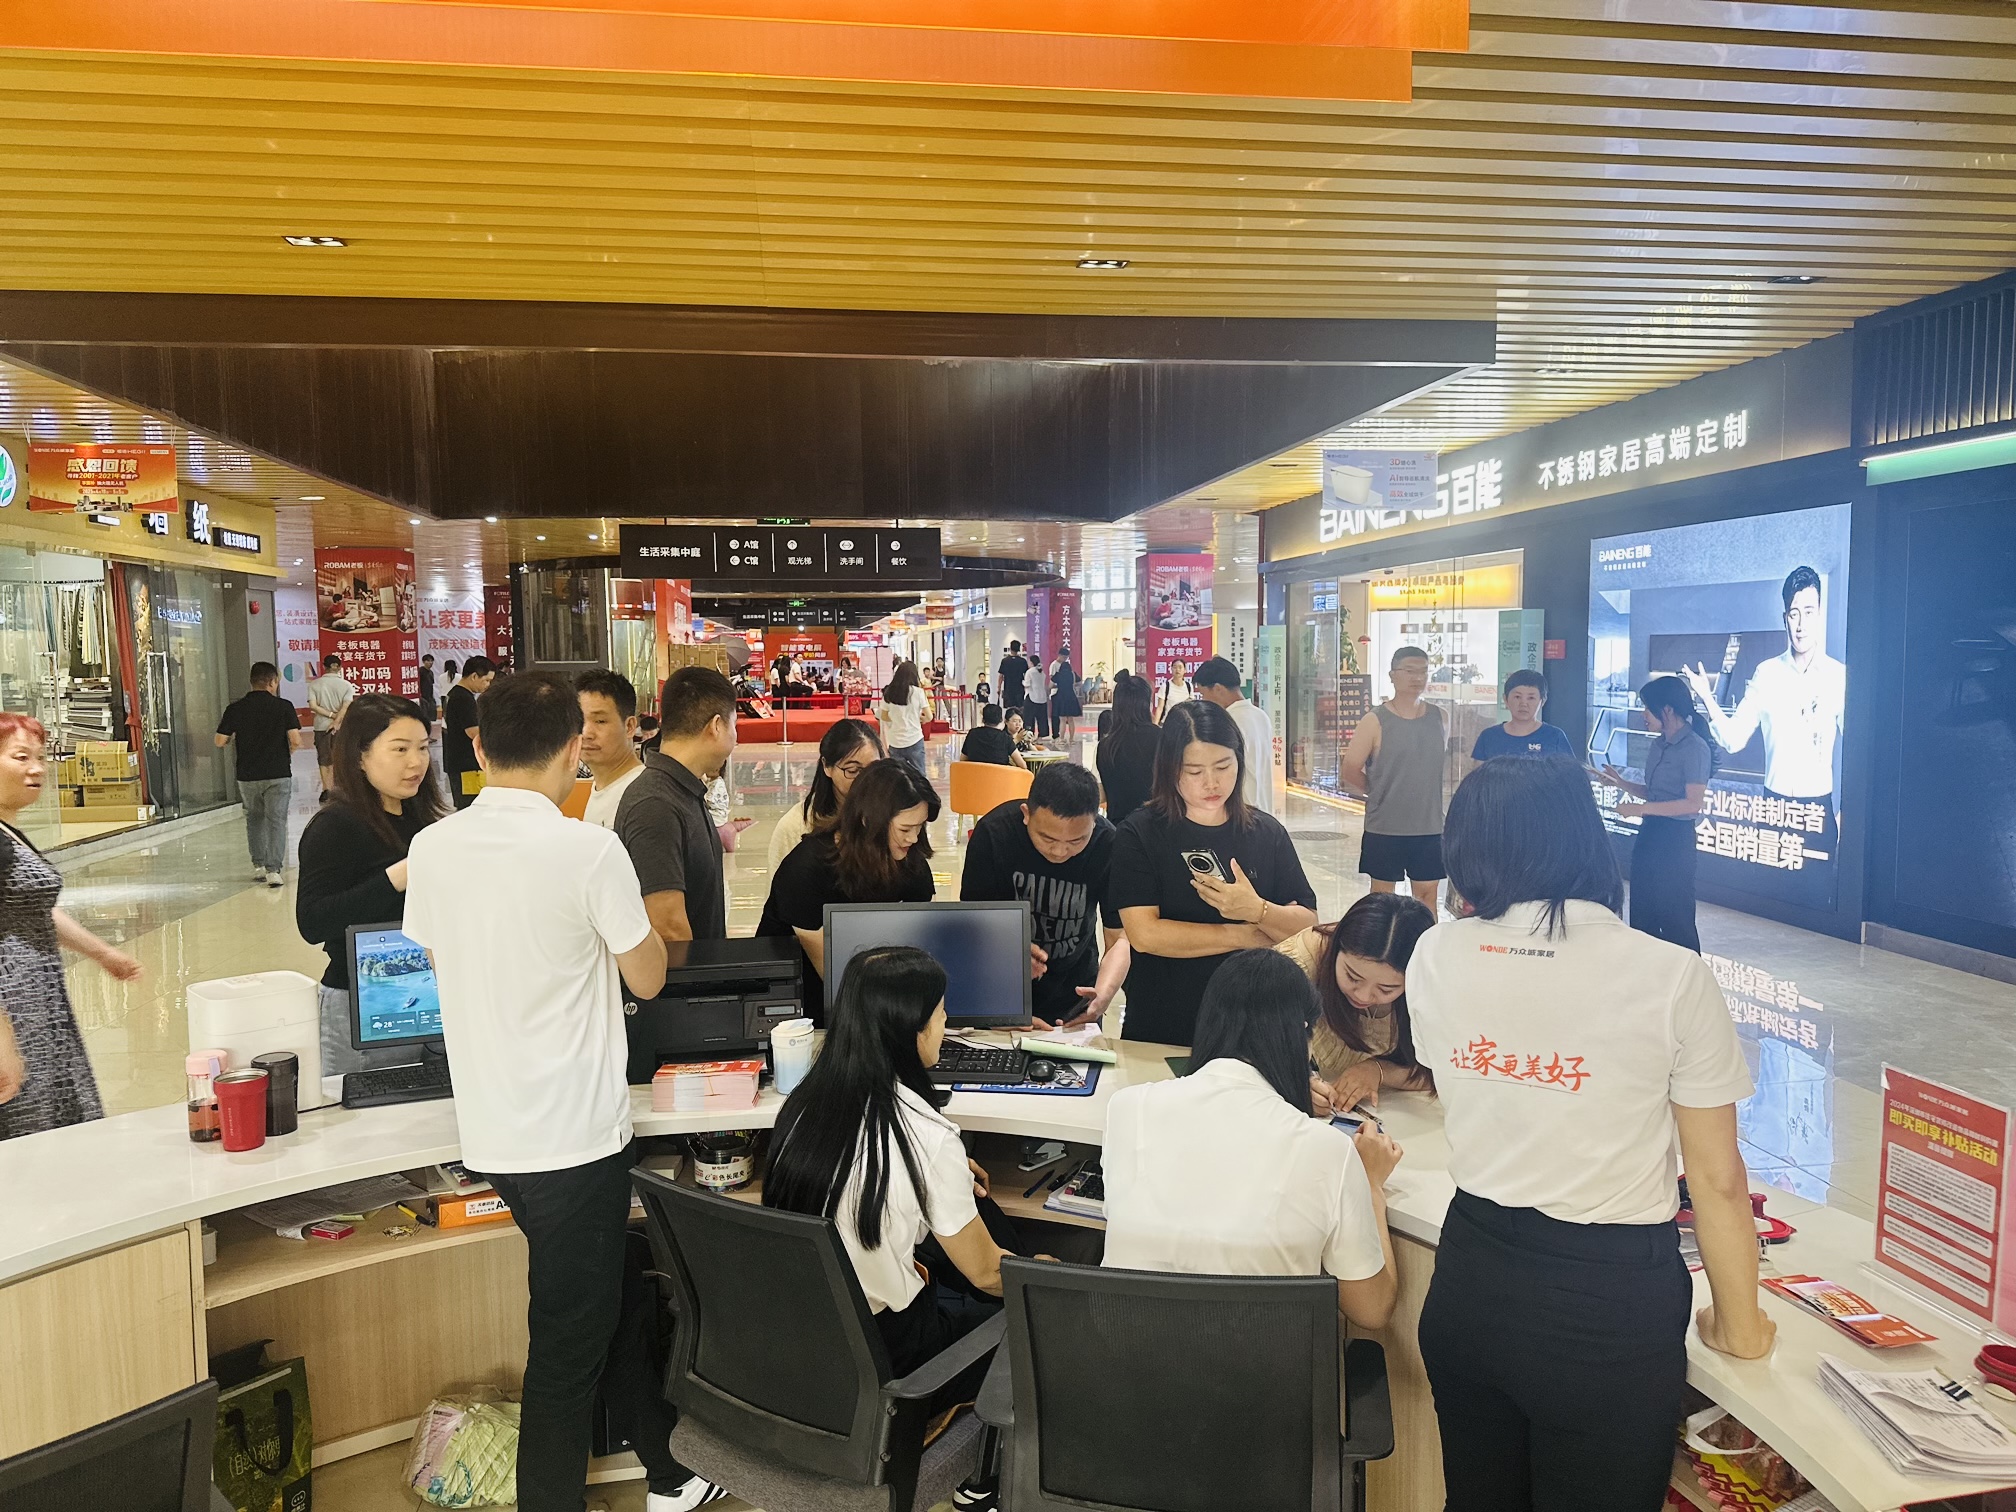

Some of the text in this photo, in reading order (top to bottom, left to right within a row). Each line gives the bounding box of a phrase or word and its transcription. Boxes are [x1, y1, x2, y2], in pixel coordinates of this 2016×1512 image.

[1537, 409, 1748, 490] 不锈钢家居高端定制
[66, 458, 138, 474] 感恩回馈
[744, 540, 759, 550] A馆
[639, 546, 701, 558] 生活采集中庭
[744, 556, 759, 566] C馆
[788, 556, 812, 566] 观光梯
[840, 557, 864, 566] 洗手间
[891, 557, 907, 566] 餐饮
[337, 640, 380, 650] 老板电器
[1162, 638, 1198, 646] 老板电器
[1158, 648, 1202, 656] 家宴年货节
[1695, 818, 1829, 870] 全国销量第一
[1012, 871, 1087, 920] CALVIN
[1479, 944, 1508, 954] WONDE
[625, 1002, 636, 1015] hp
[1450, 1034, 1592, 1092] 让家更美好
[1889, 1108, 1998, 1167] 即买即享补贴活动
